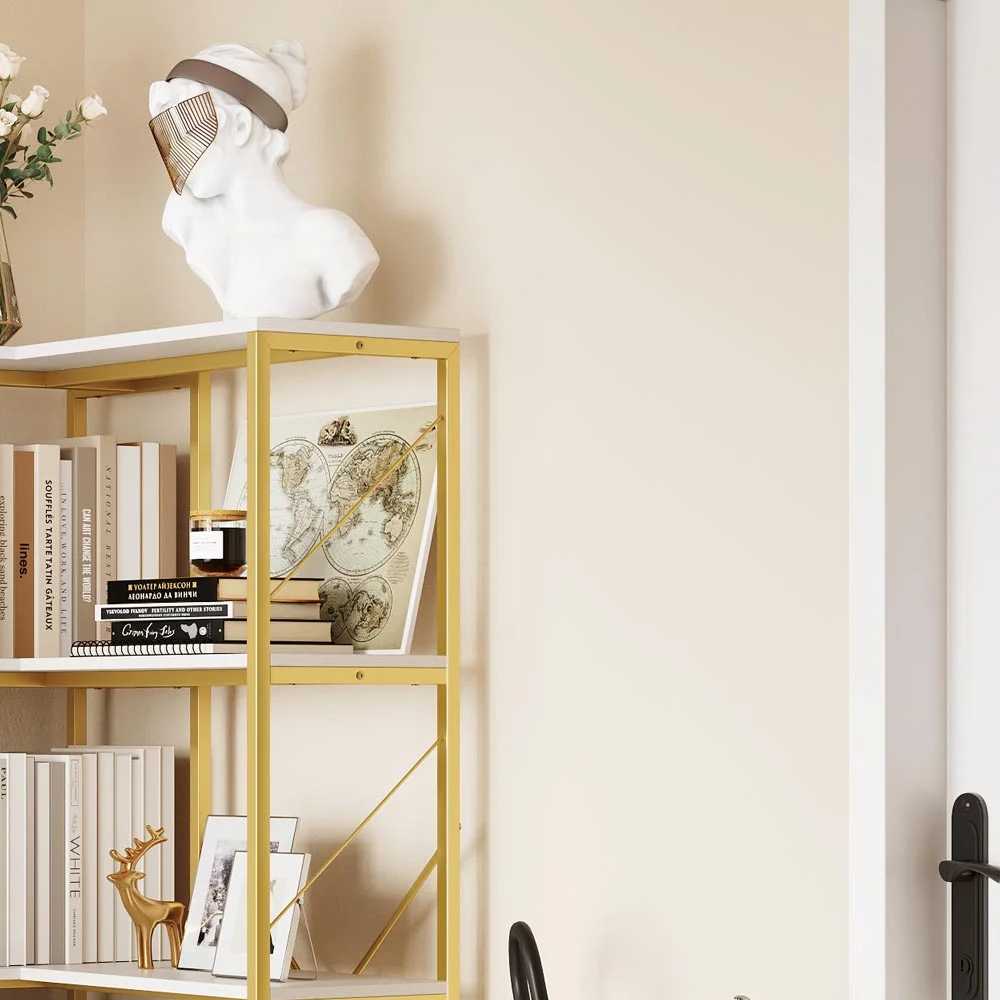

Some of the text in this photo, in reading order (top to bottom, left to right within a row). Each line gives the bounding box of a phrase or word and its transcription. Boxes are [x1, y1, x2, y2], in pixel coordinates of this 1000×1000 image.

[0, 539, 8, 563] black
[19, 543, 30, 579] lines.
[45, 480, 55, 631] SOUFFLÉS TARTE TATIN GÂTEAUX
[82, 508, 91, 603] CAN ART CHANGE THE WORLD?
[0, 564, 8, 585] sand
[158, 581, 191, 590] АЙЗЕКСОН
[0, 586, 8, 621] beaches
[128, 592, 161, 600] ЛЕОНАРДО
[174, 590, 197, 599] ВИНЧИ
[70, 835, 81, 898] WHITE
